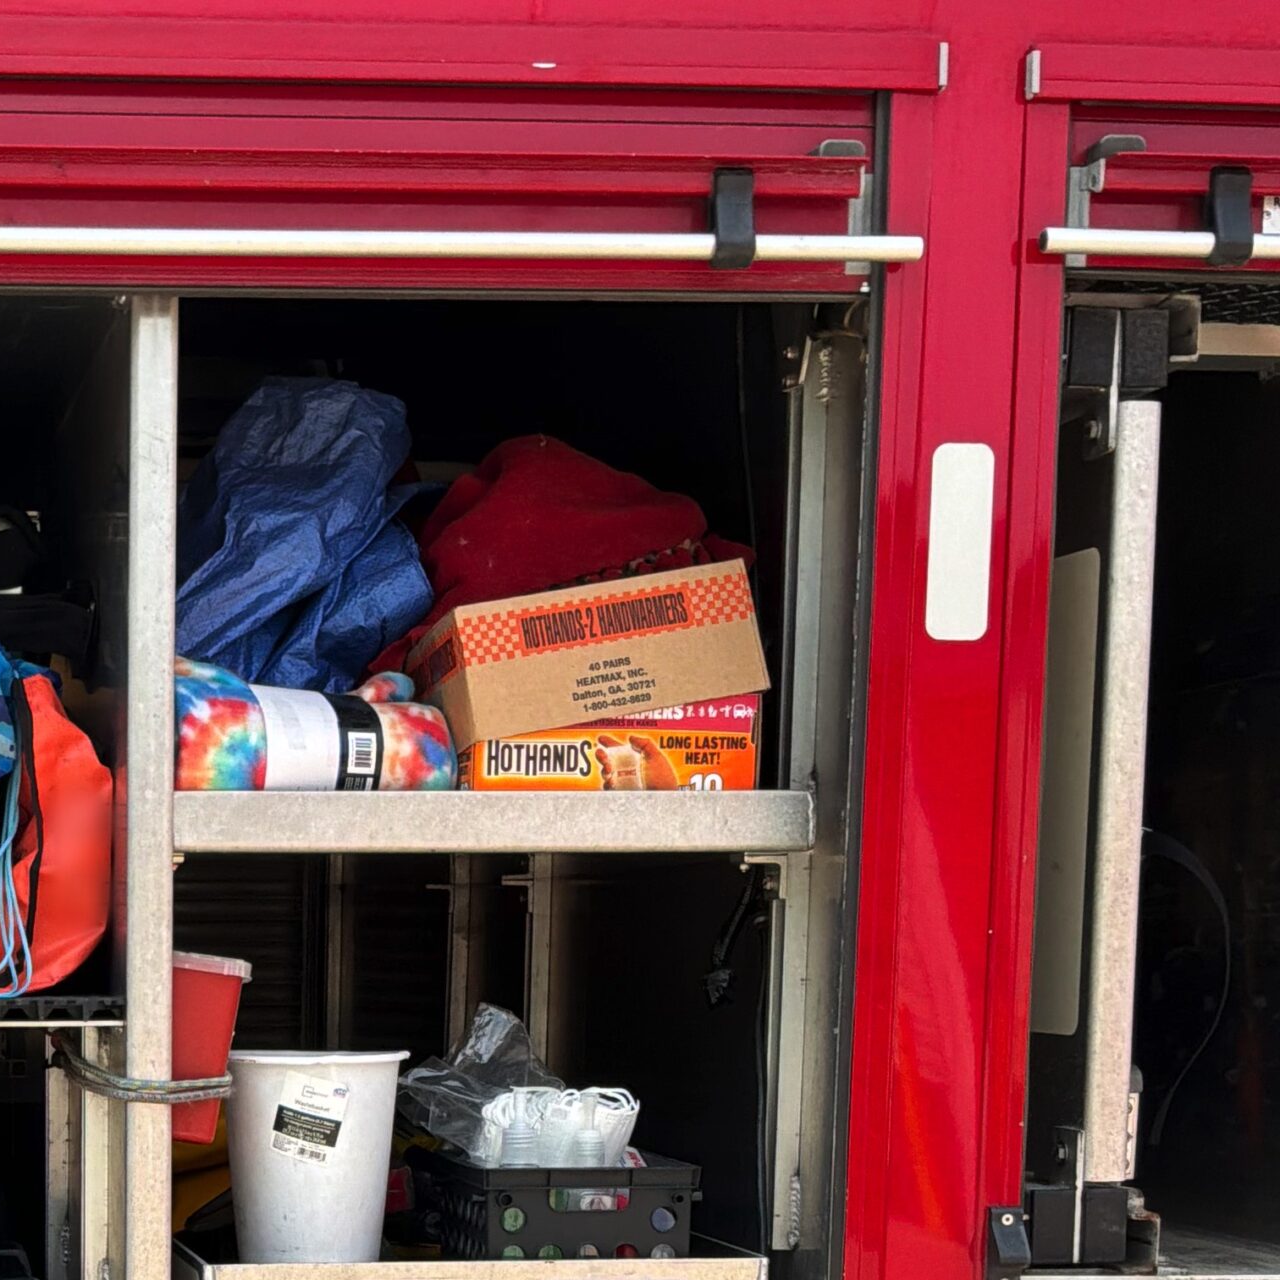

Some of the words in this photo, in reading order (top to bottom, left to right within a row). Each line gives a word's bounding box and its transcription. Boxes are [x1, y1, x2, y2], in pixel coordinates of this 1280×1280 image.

[521, 607, 597, 649] HOTHANDS-2
[596, 592, 688, 636] HANDWARMERS
[588, 662, 601, 672] 40
[603, 657, 631, 669] PAIRS
[576, 671, 626, 687] HEATMAX,
[627, 668, 648, 677] INC.
[572, 690, 606, 701] Dalton,
[627, 679, 656, 691] 30721
[659, 736, 691, 750] LONG
[694, 737, 747, 750] LASTING
[486, 739, 592, 777] HOTHANDS
[685, 752, 720, 765] HEAT!
